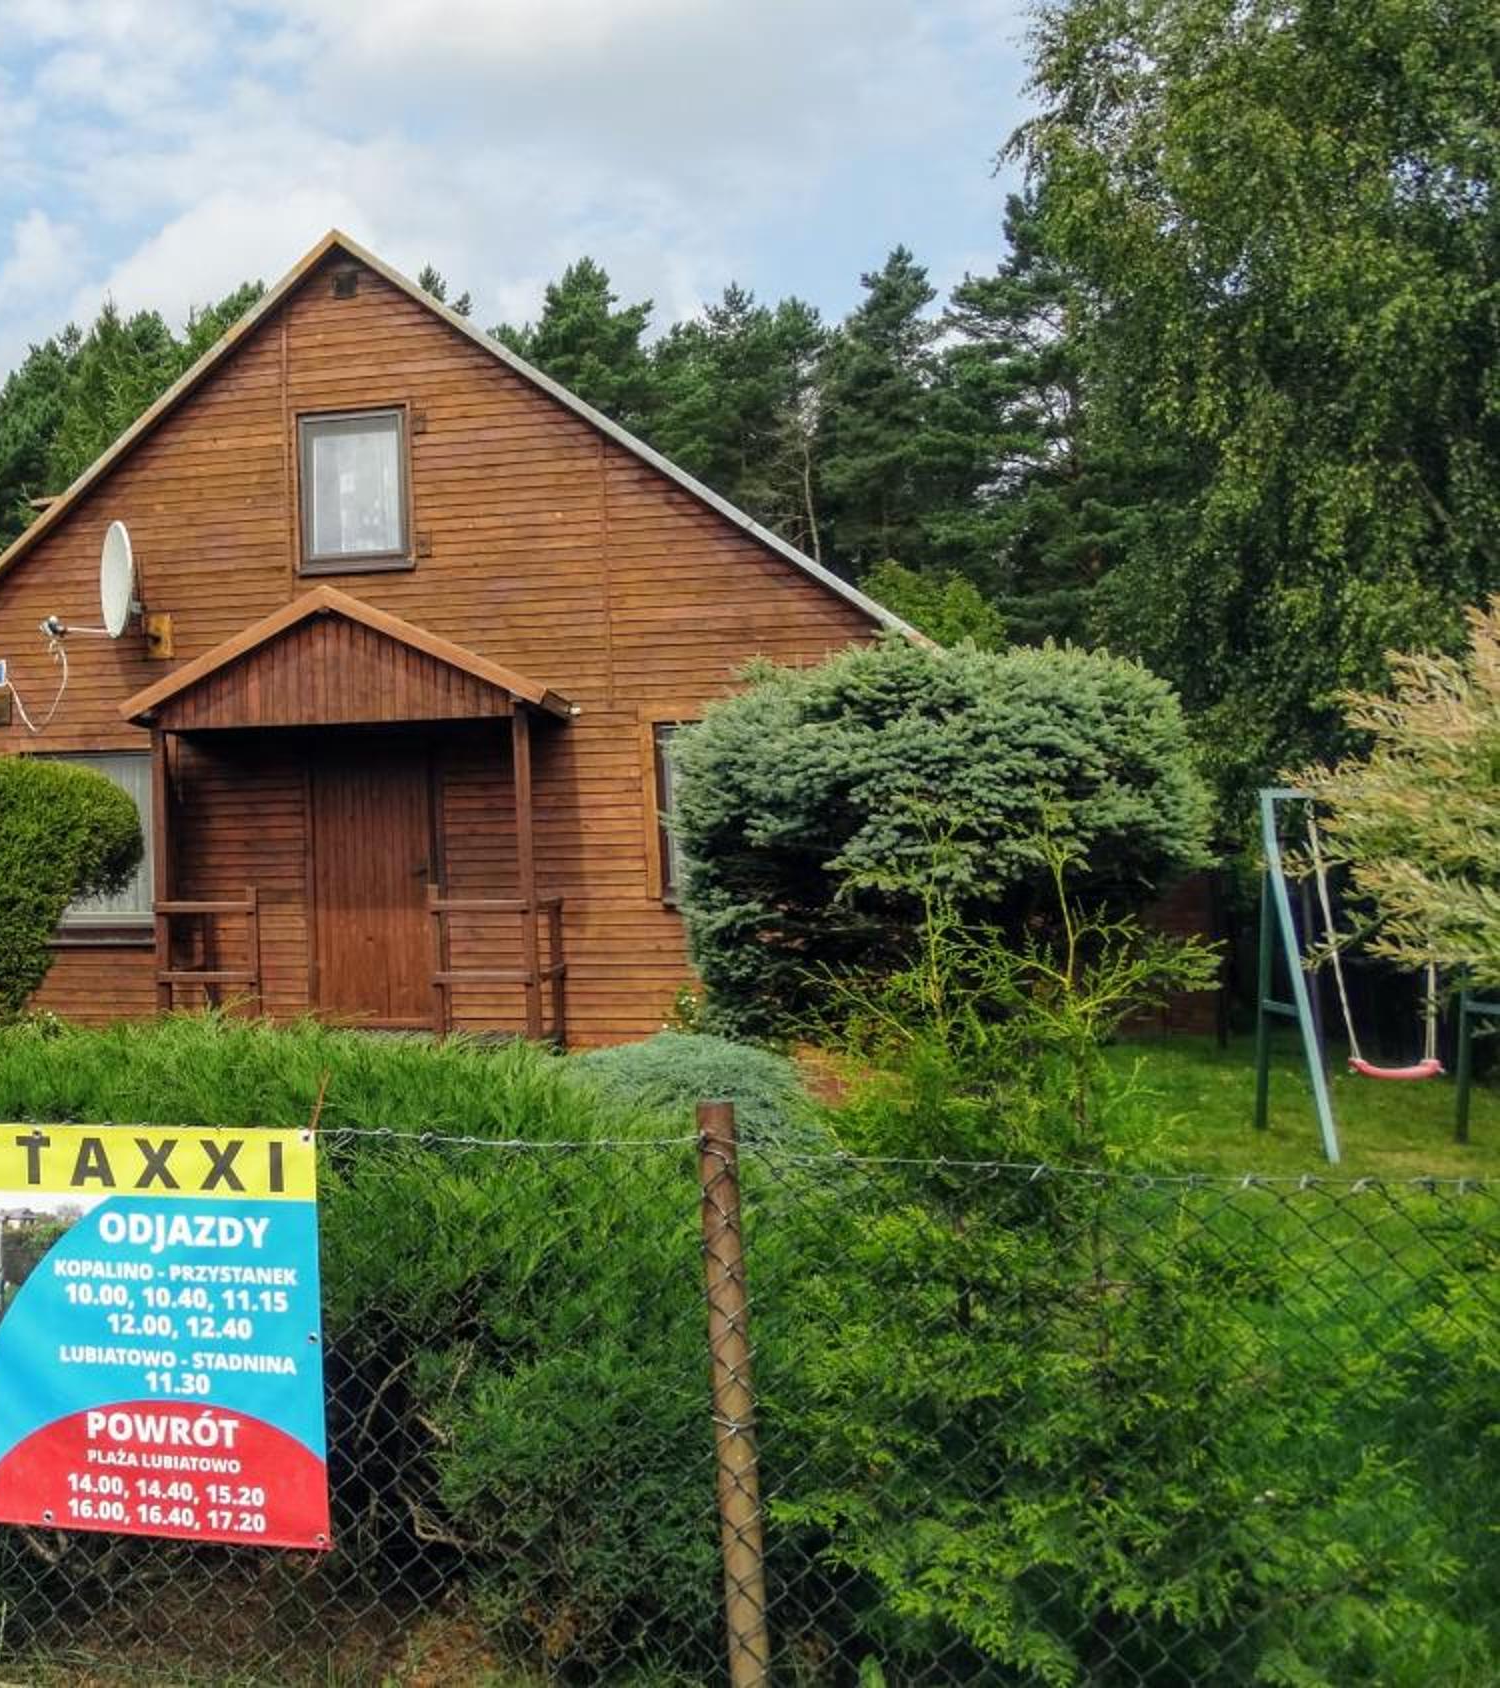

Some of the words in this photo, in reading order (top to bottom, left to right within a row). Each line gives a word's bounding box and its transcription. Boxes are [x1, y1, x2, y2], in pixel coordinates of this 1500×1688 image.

[16, 1135, 284, 1192] TAXXI
[99, 1212, 270, 1253] ODJAZDY
[54, 1260, 153, 1280] KOPALINO
[169, 1265, 297, 1286] PRZYSTANEK
[64, 1283, 134, 1310] 10.00,
[142, 1287, 215, 1312] 10.40,
[222, 1290, 288, 1312] 11.15
[106, 1313, 179, 1340] 12.00,
[186, 1316, 252, 1340] 12.40
[59, 1345, 176, 1368] LUBIATOWO
[192, 1352, 297, 1375] STADNINA
[145, 1371, 211, 1395] 11.30
[87, 1410, 239, 1448] POWRÓT
[87, 1449, 138, 1467] PLAŻA
[142, 1454, 241, 1473] LUBIATOWO
[68, 1473, 130, 1499] 14.00,
[136, 1479, 200, 1505] 14.40,
[206, 1485, 265, 1507] 15.20
[68, 1499, 131, 1525] 16.00,
[137, 1504, 201, 1531] 16.40,
[207, 1510, 266, 1533] 17.20
